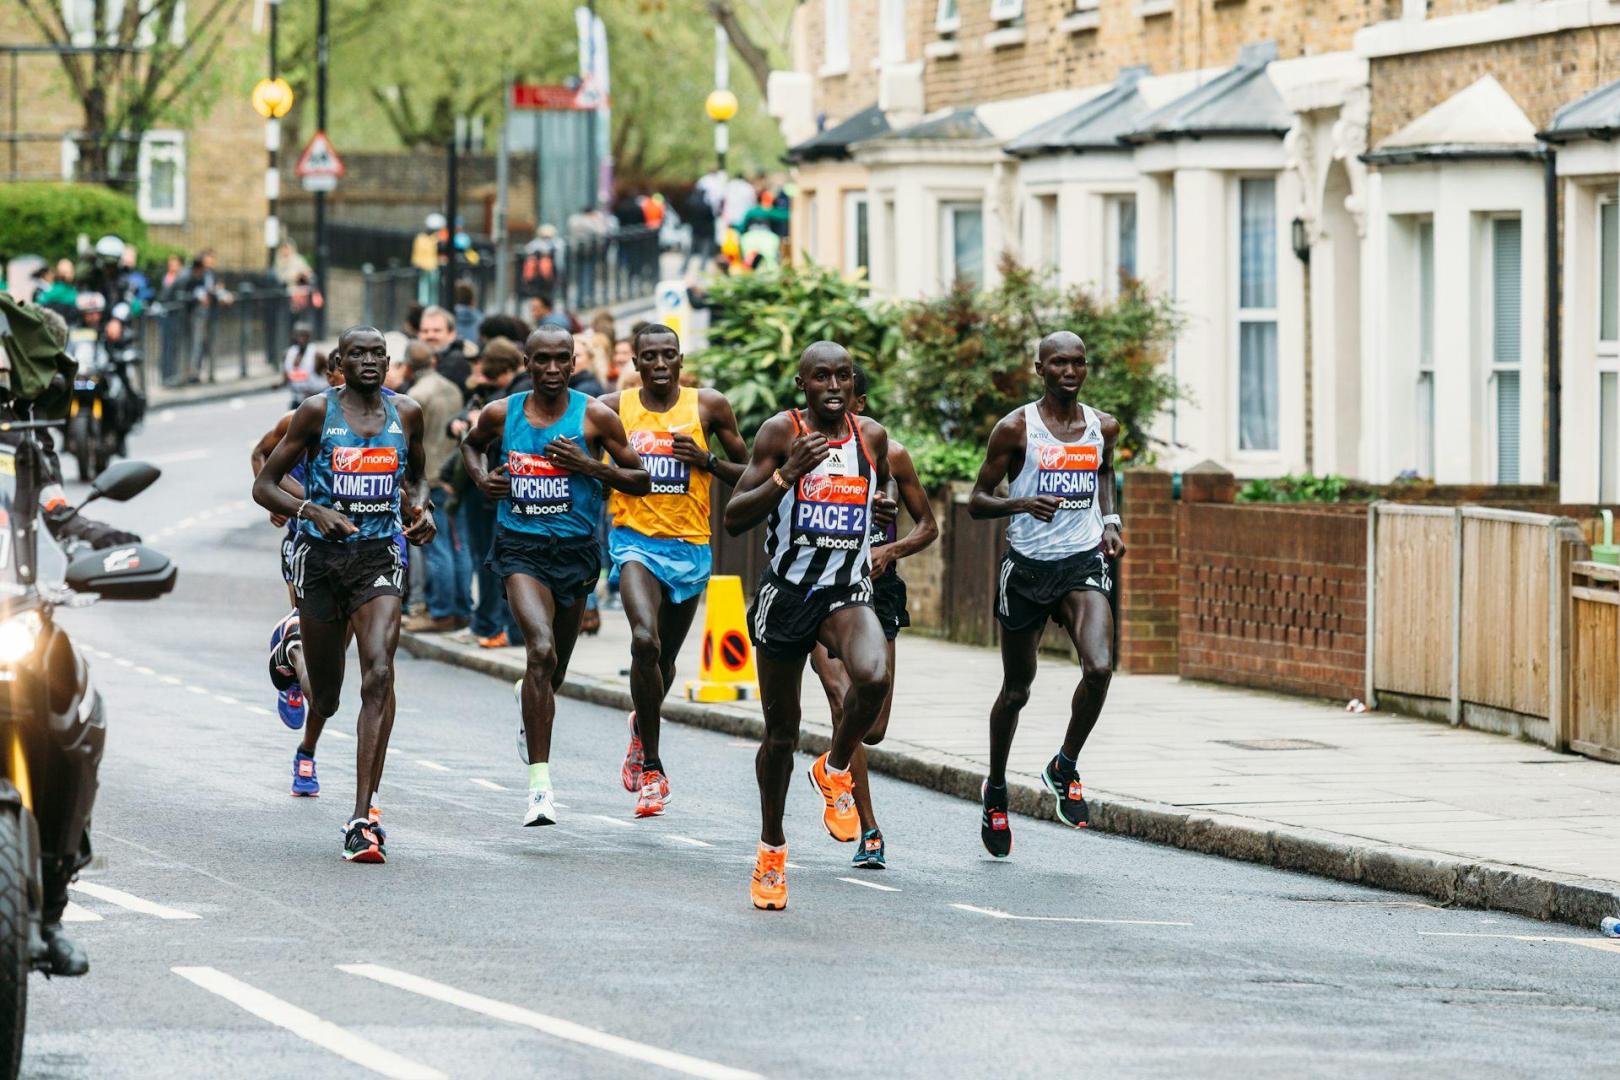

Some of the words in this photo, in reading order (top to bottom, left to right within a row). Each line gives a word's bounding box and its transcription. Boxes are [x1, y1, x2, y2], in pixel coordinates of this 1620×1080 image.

[326, 427, 348, 436] AKTIV
[363, 455, 396, 465] money
[640, 456, 685, 478] WOTT
[1067, 454, 1096, 463] money
[333, 474, 393, 496] KIMETTO
[511, 477, 569, 499] KIPCHOGE
[803, 474, 832, 499] Virgin
[833, 484, 866, 496] money
[1040, 472, 1094, 493] KIPSANG
[525, 503, 569, 515] #boost
[798, 503, 849, 530] PACE
[853, 508, 864, 531] 2
[816, 535, 859, 549] #boost
